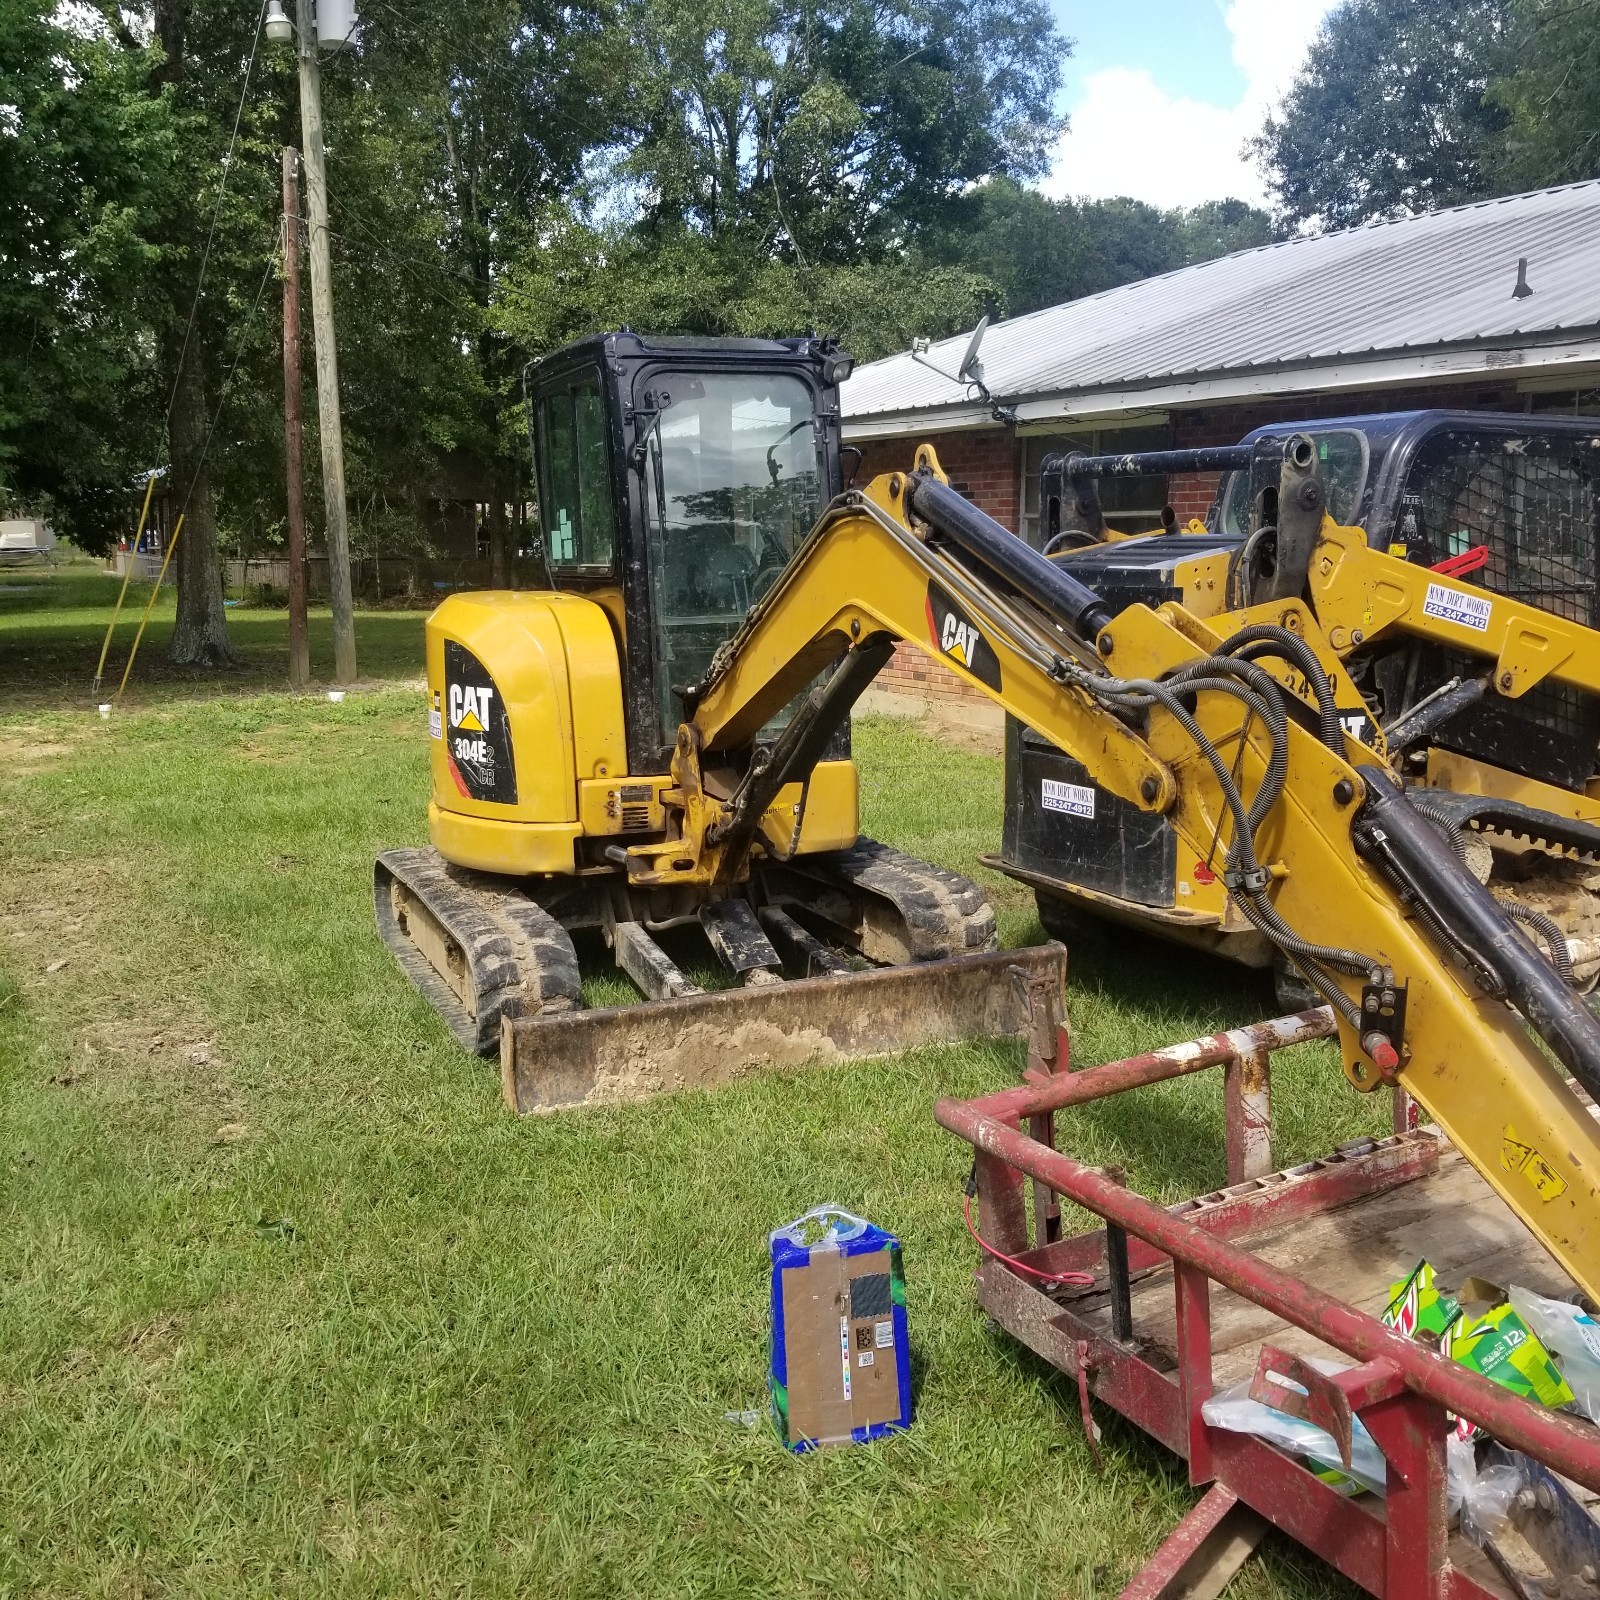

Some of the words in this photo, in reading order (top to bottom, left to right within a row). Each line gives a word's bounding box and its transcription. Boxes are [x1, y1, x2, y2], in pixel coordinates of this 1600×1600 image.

[1428, 586, 1445, 602] MNM
[1446, 592, 1464, 608] DIRT
[1466, 598, 1491, 616] WORKS
[1426, 603, 1486, 628] 225-247-4912
[942, 612, 980, 668] CAT
[449, 684, 493, 732] CAT
[480, 767, 496, 785] CR
[1057, 785, 1071, 799] DIRT
[1073, 787, 1093, 803] WORKS
[1044, 797, 1092, 815] 225-247-4912
[1502, 1330, 1523, 1347] 12
